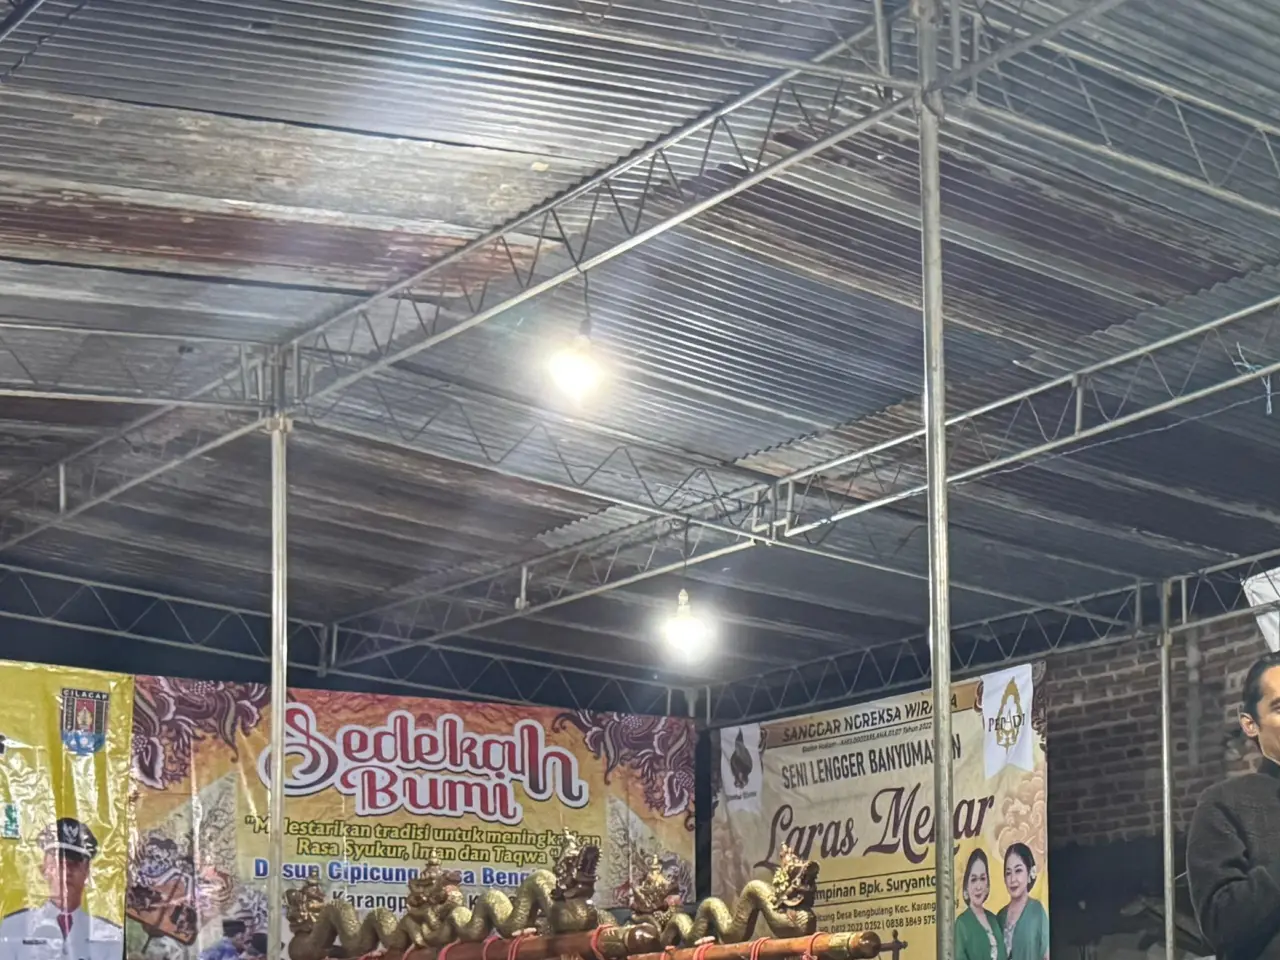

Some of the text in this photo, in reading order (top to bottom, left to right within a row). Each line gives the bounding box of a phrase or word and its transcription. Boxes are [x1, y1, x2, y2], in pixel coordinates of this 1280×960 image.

[63, 690, 107, 699] CILACAP
[782, 693, 958, 743] SANGGAR NGREKSA WIRA
[988, 708, 1025, 732] PEPADI
[260, 703, 588, 808] Sedekah
[781, 733, 961, 790] SENI LENGGER BANYUMAN
[338, 763, 522, 823] Bumi
[245, 815, 602, 848] "Mlestarikan tradisi untuk meningkakan
[753, 782, 995, 873] Laras Mear
[297, 837, 339, 856] Rasa
[344, 839, 409, 861] Syukur,
[412, 843, 456, 862] Iman
[458, 845, 491, 862] dan
[255, 858, 419, 884] Dsun Cipicung
[816, 883, 856, 901] mpinan
[859, 881, 884, 897] Bpk.
[836, 911, 852, 920] Desa
[895, 904, 910, 914] Kec.
